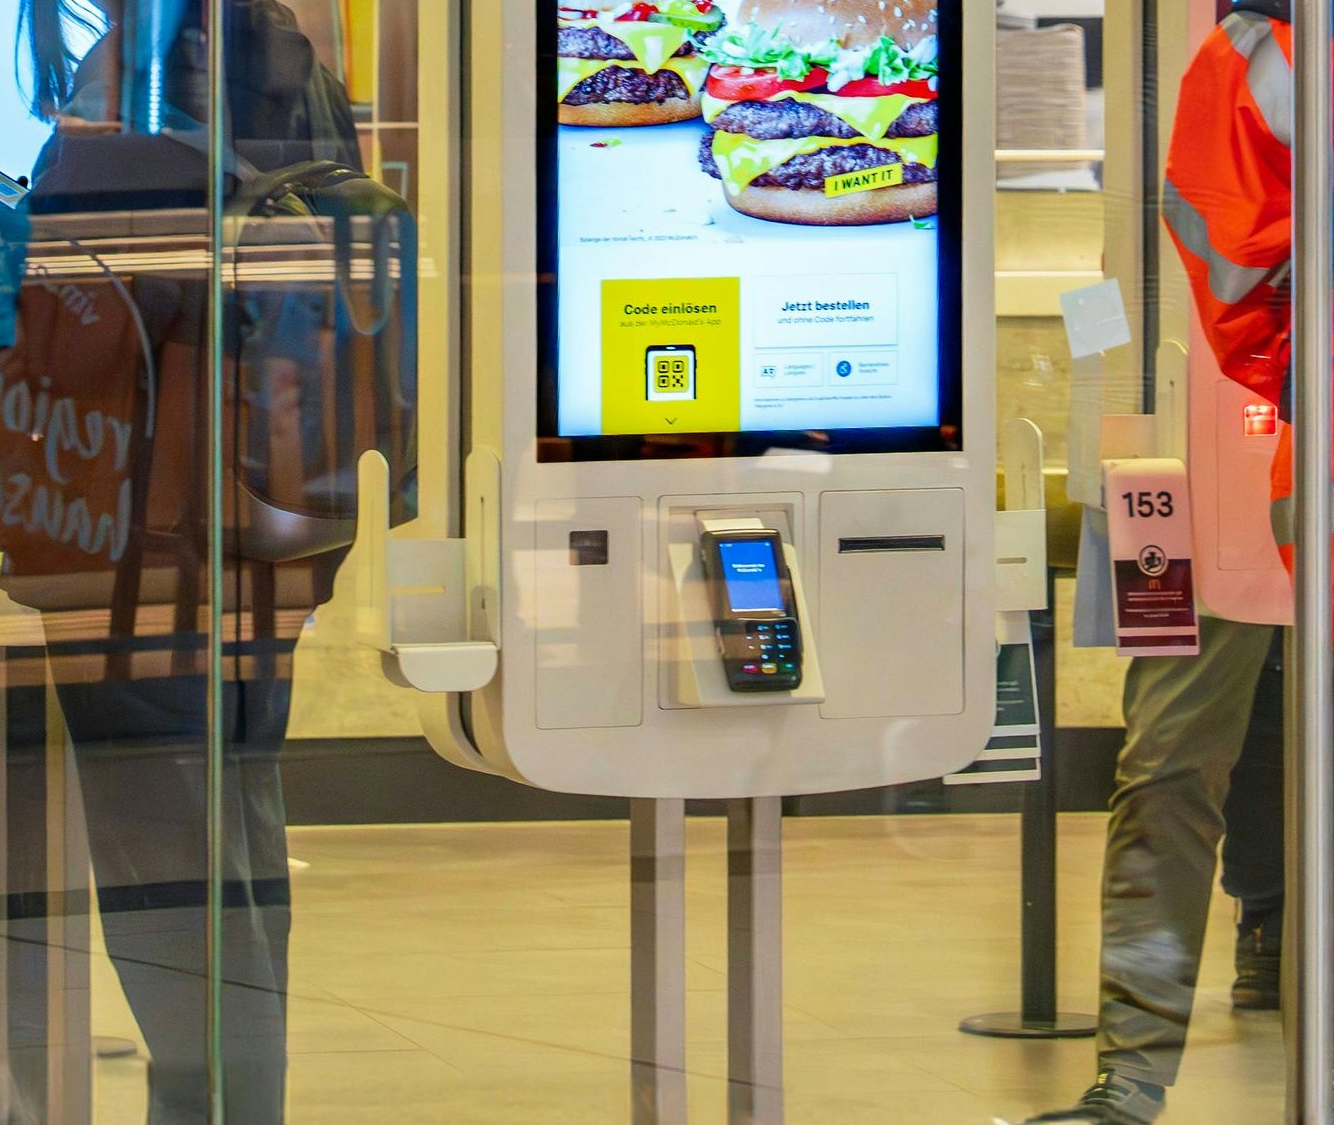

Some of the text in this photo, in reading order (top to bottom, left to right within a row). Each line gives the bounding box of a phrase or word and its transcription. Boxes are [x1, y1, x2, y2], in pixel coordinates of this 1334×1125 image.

[841, 172, 878, 190] WANT
[881, 169, 894, 181] IT
[624, 302, 717, 315] Code einlösen
[781, 299, 870, 312] Jetzt bestellen
[1121, 491, 1174, 518] 153
